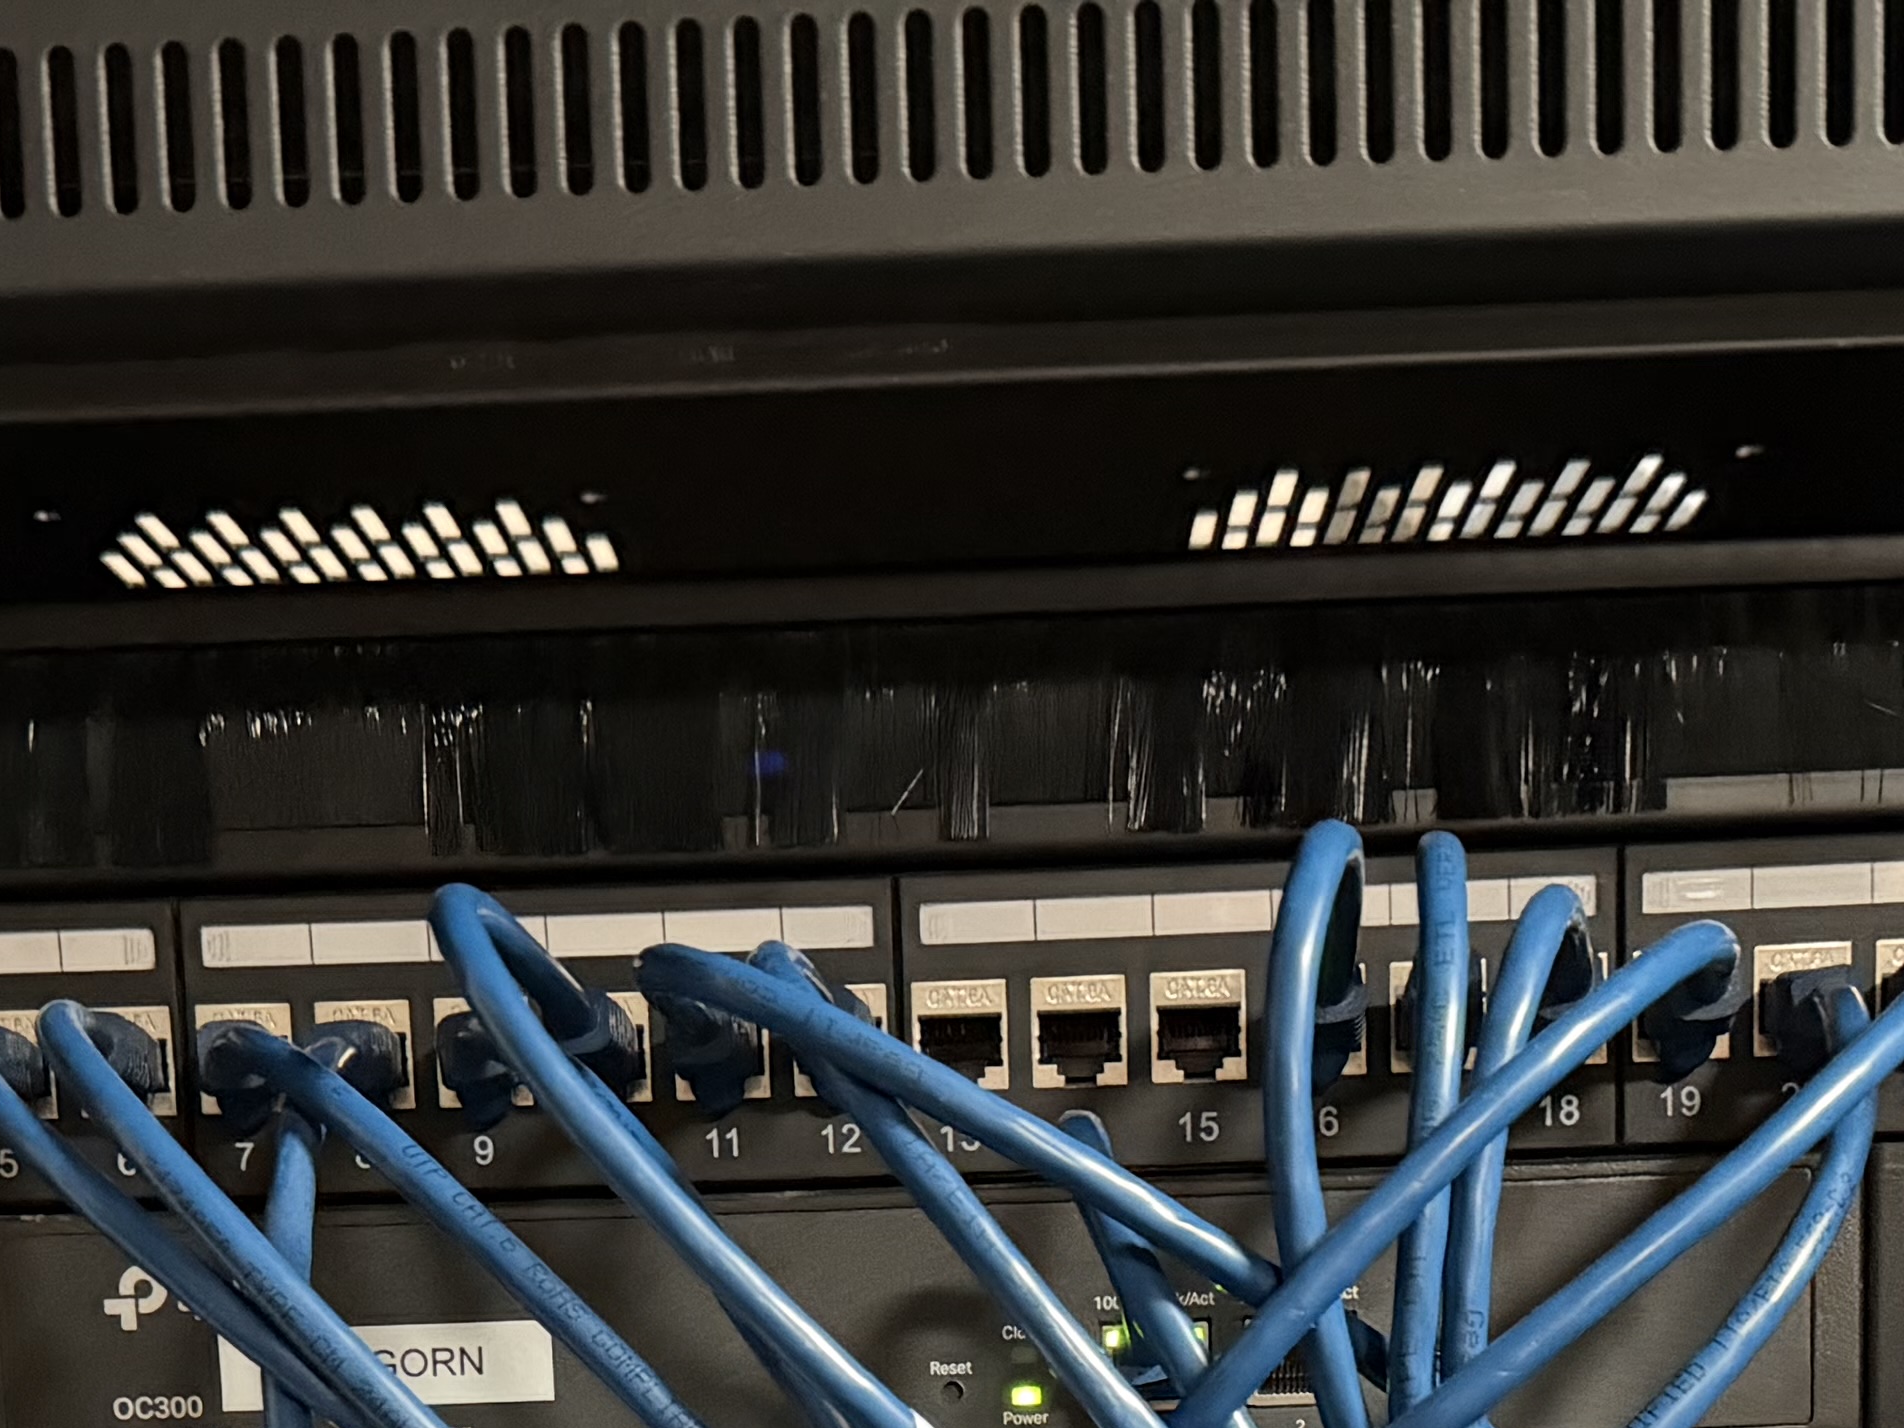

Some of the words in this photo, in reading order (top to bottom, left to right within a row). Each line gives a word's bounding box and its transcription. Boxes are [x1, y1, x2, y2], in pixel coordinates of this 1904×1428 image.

[1660, 1086, 1701, 1116] 19
[1179, 1112, 1220, 1142] 15
[1540, 1096, 1579, 1126] 18
[235, 1143, 255, 1171] 7
[474, 1136, 494, 1165] 9
[705, 1128, 741, 1158] 11
[820, 1123, 862, 1154] 12
[0, 1149, 19, 1178] 5
[402, 1144, 448, 1181] UTP
[377, 1345, 485, 1377] GORN
[930, 1360, 972, 1376] Reset
[113, 1397, 203, 1420] OC300
[1002, 1411, 1049, 1426] Power
